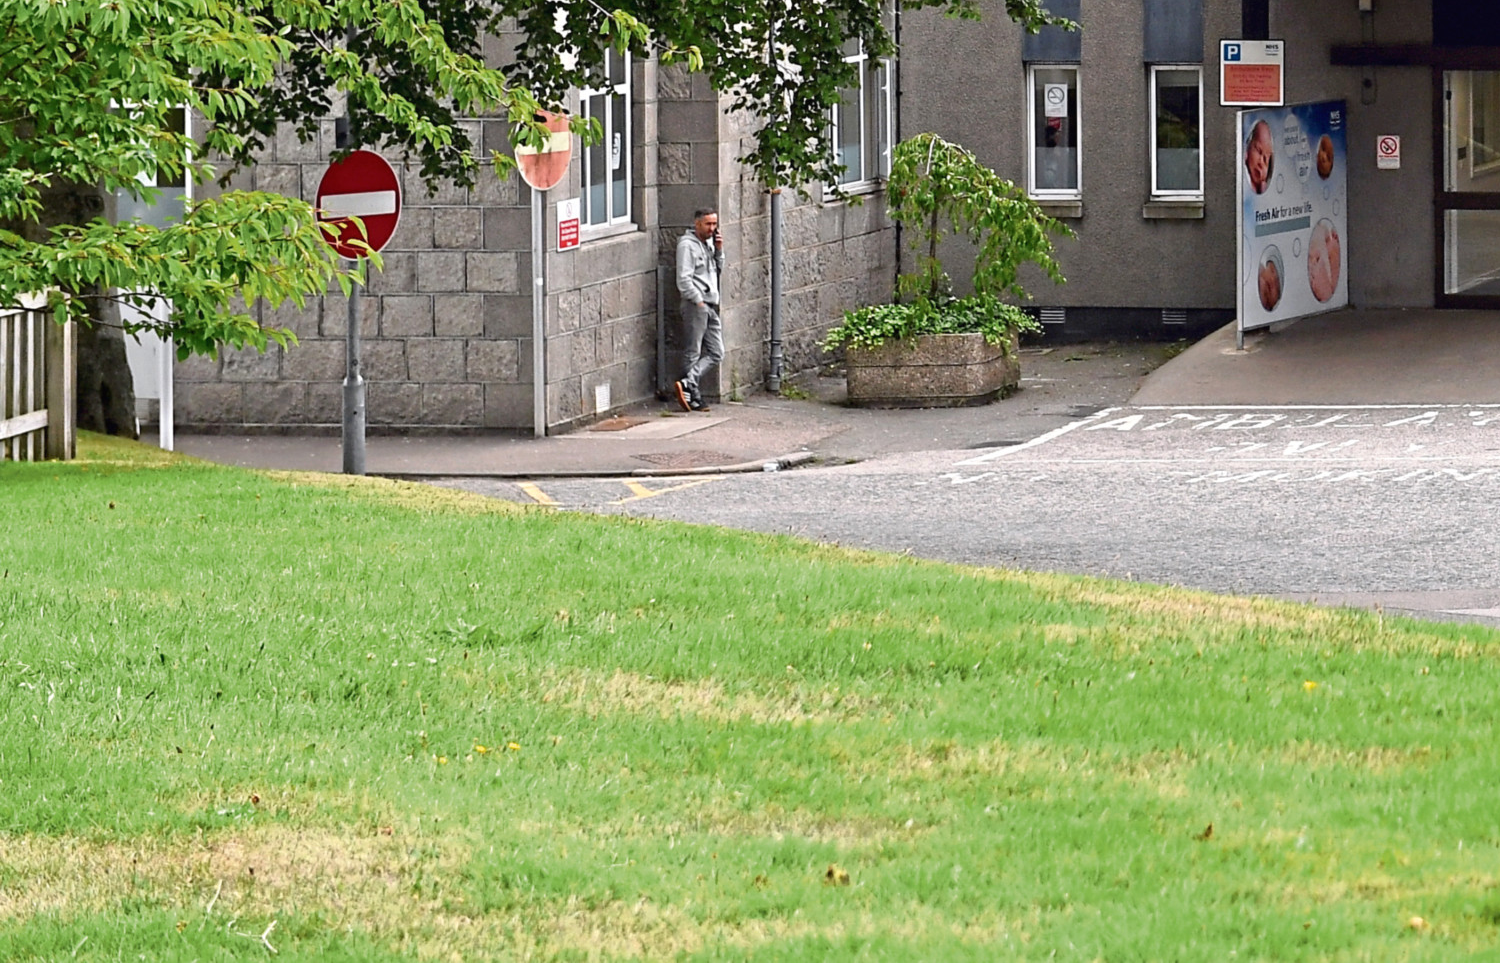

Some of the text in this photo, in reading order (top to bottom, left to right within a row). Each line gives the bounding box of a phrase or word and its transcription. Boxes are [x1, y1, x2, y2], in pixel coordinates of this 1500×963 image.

[1227, 45, 1239, 60] P
[1255, 208, 1271, 222] Fresh
[1271, 206, 1280, 219] Air
[1280, 205, 1288, 217] for
[1292, 205, 1303, 215] new
